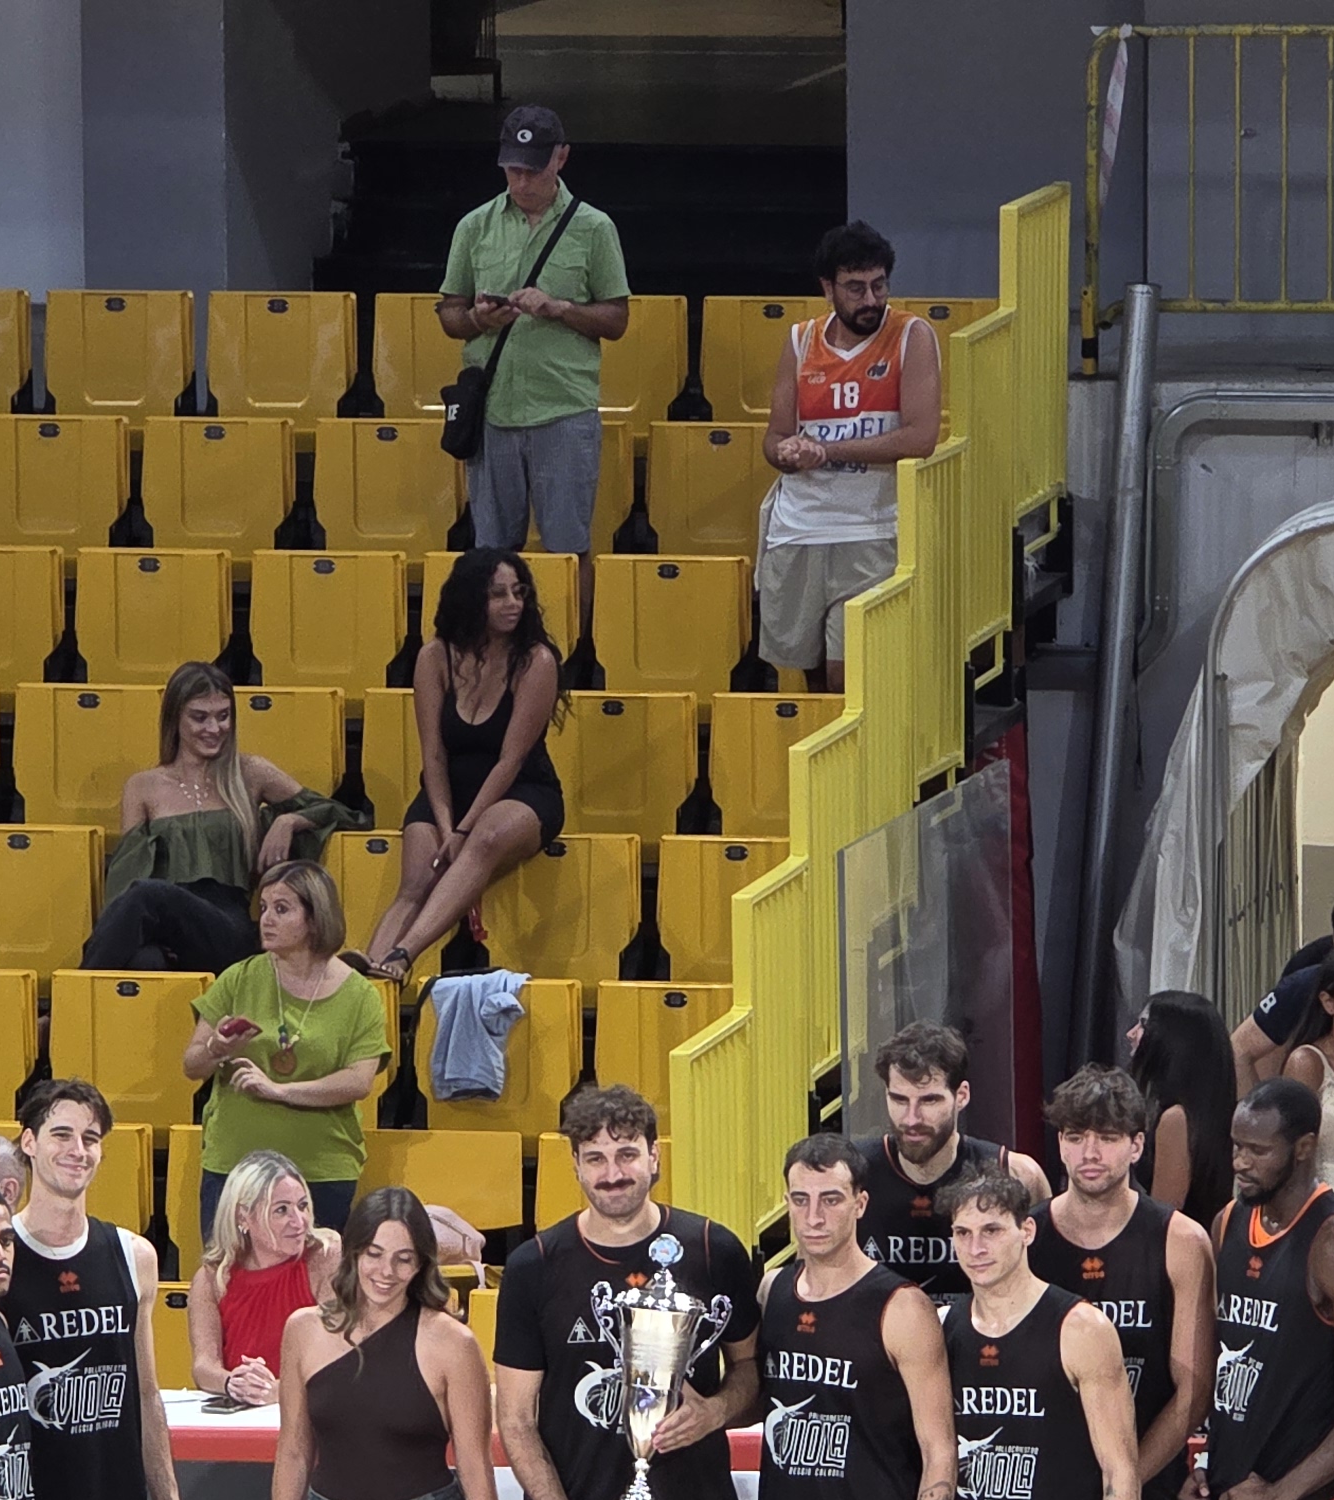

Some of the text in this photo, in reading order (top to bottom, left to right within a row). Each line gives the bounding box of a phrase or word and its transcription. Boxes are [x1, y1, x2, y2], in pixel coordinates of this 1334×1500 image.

[829, 381, 860, 411] 18
[39, 1305, 130, 1342] REDEL
[778, 1350, 859, 1390] REDEL
[55, 1372, 128, 1425] VIOLA
[961, 1386, 1046, 1418] REDEL
[782, 1418, 850, 1470] VIOLA
[971, 1451, 1037, 1500] VIOLA
